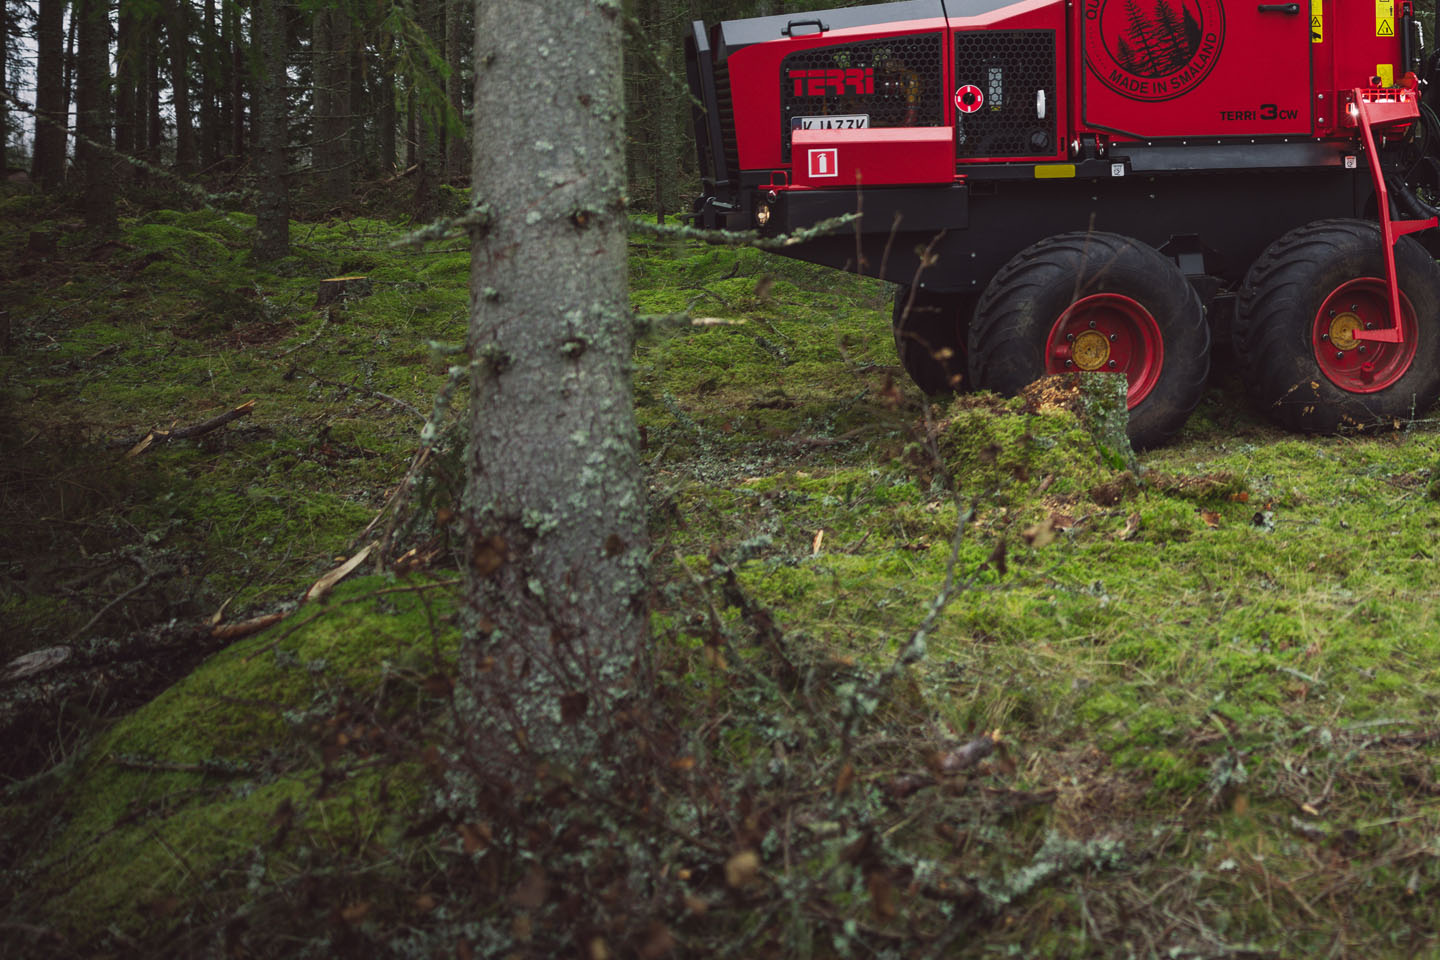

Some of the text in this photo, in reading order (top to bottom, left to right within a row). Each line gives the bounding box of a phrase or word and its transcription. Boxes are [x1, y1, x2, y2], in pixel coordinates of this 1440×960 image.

[1109, 70, 1149, 94] MADE
[1152, 81, 1167, 94] IN
[1219, 111, 1256, 121] TERRI
